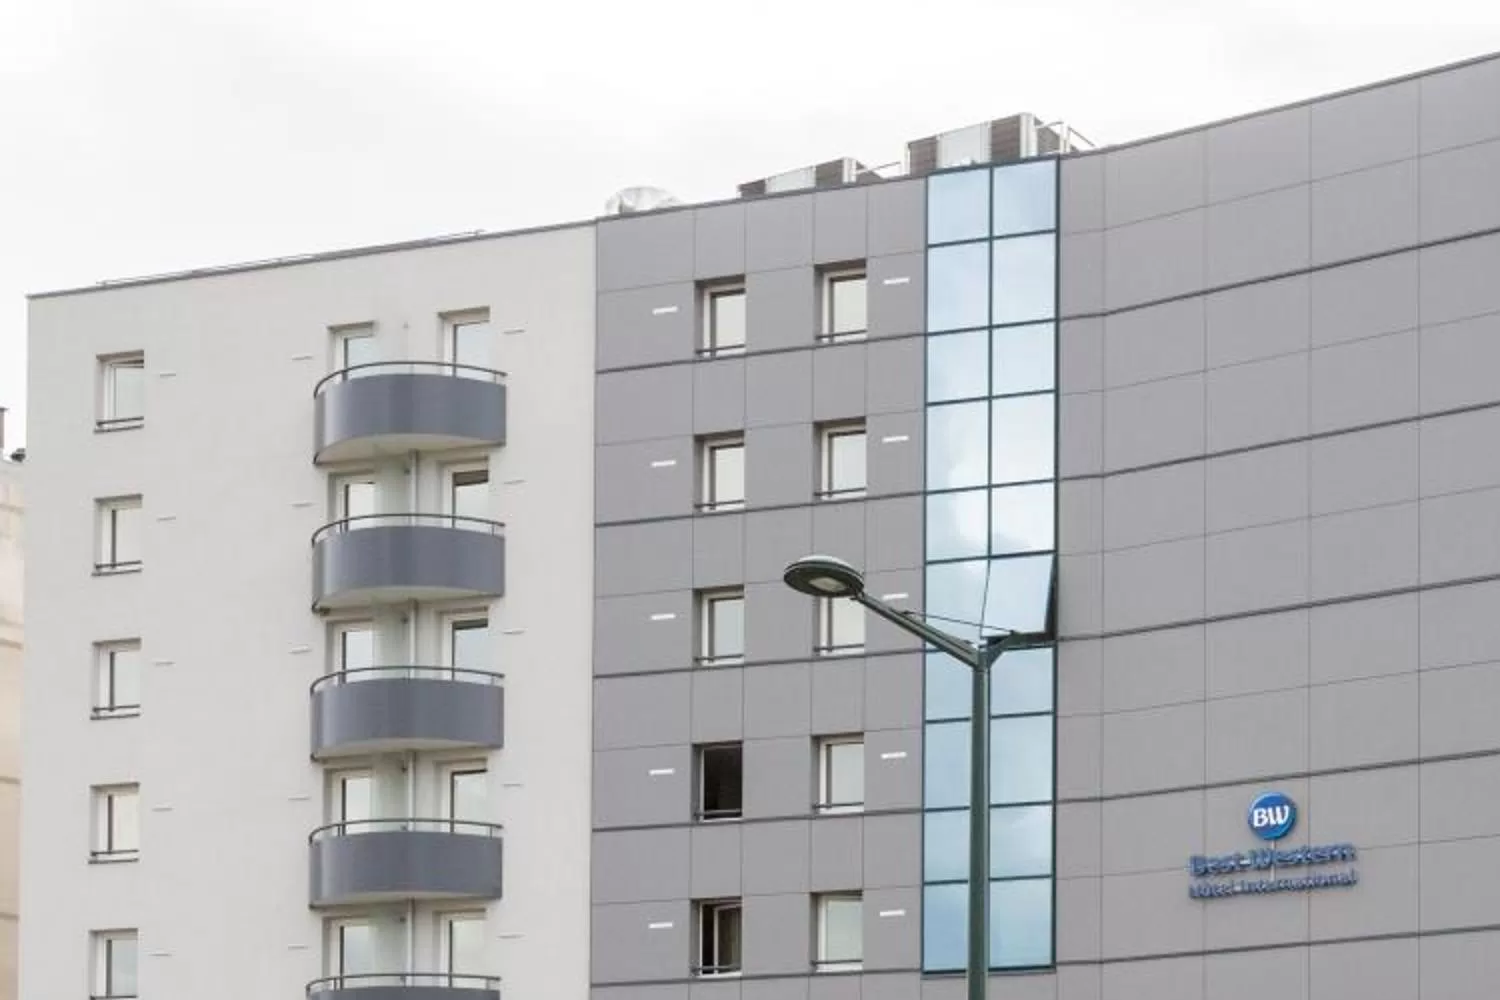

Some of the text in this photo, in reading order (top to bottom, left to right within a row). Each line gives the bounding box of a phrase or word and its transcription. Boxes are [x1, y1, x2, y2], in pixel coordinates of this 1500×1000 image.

[1253, 805, 1290, 828] BW
[1189, 843, 1357, 876] Best Western
[1241, 869, 1358, 894] International
